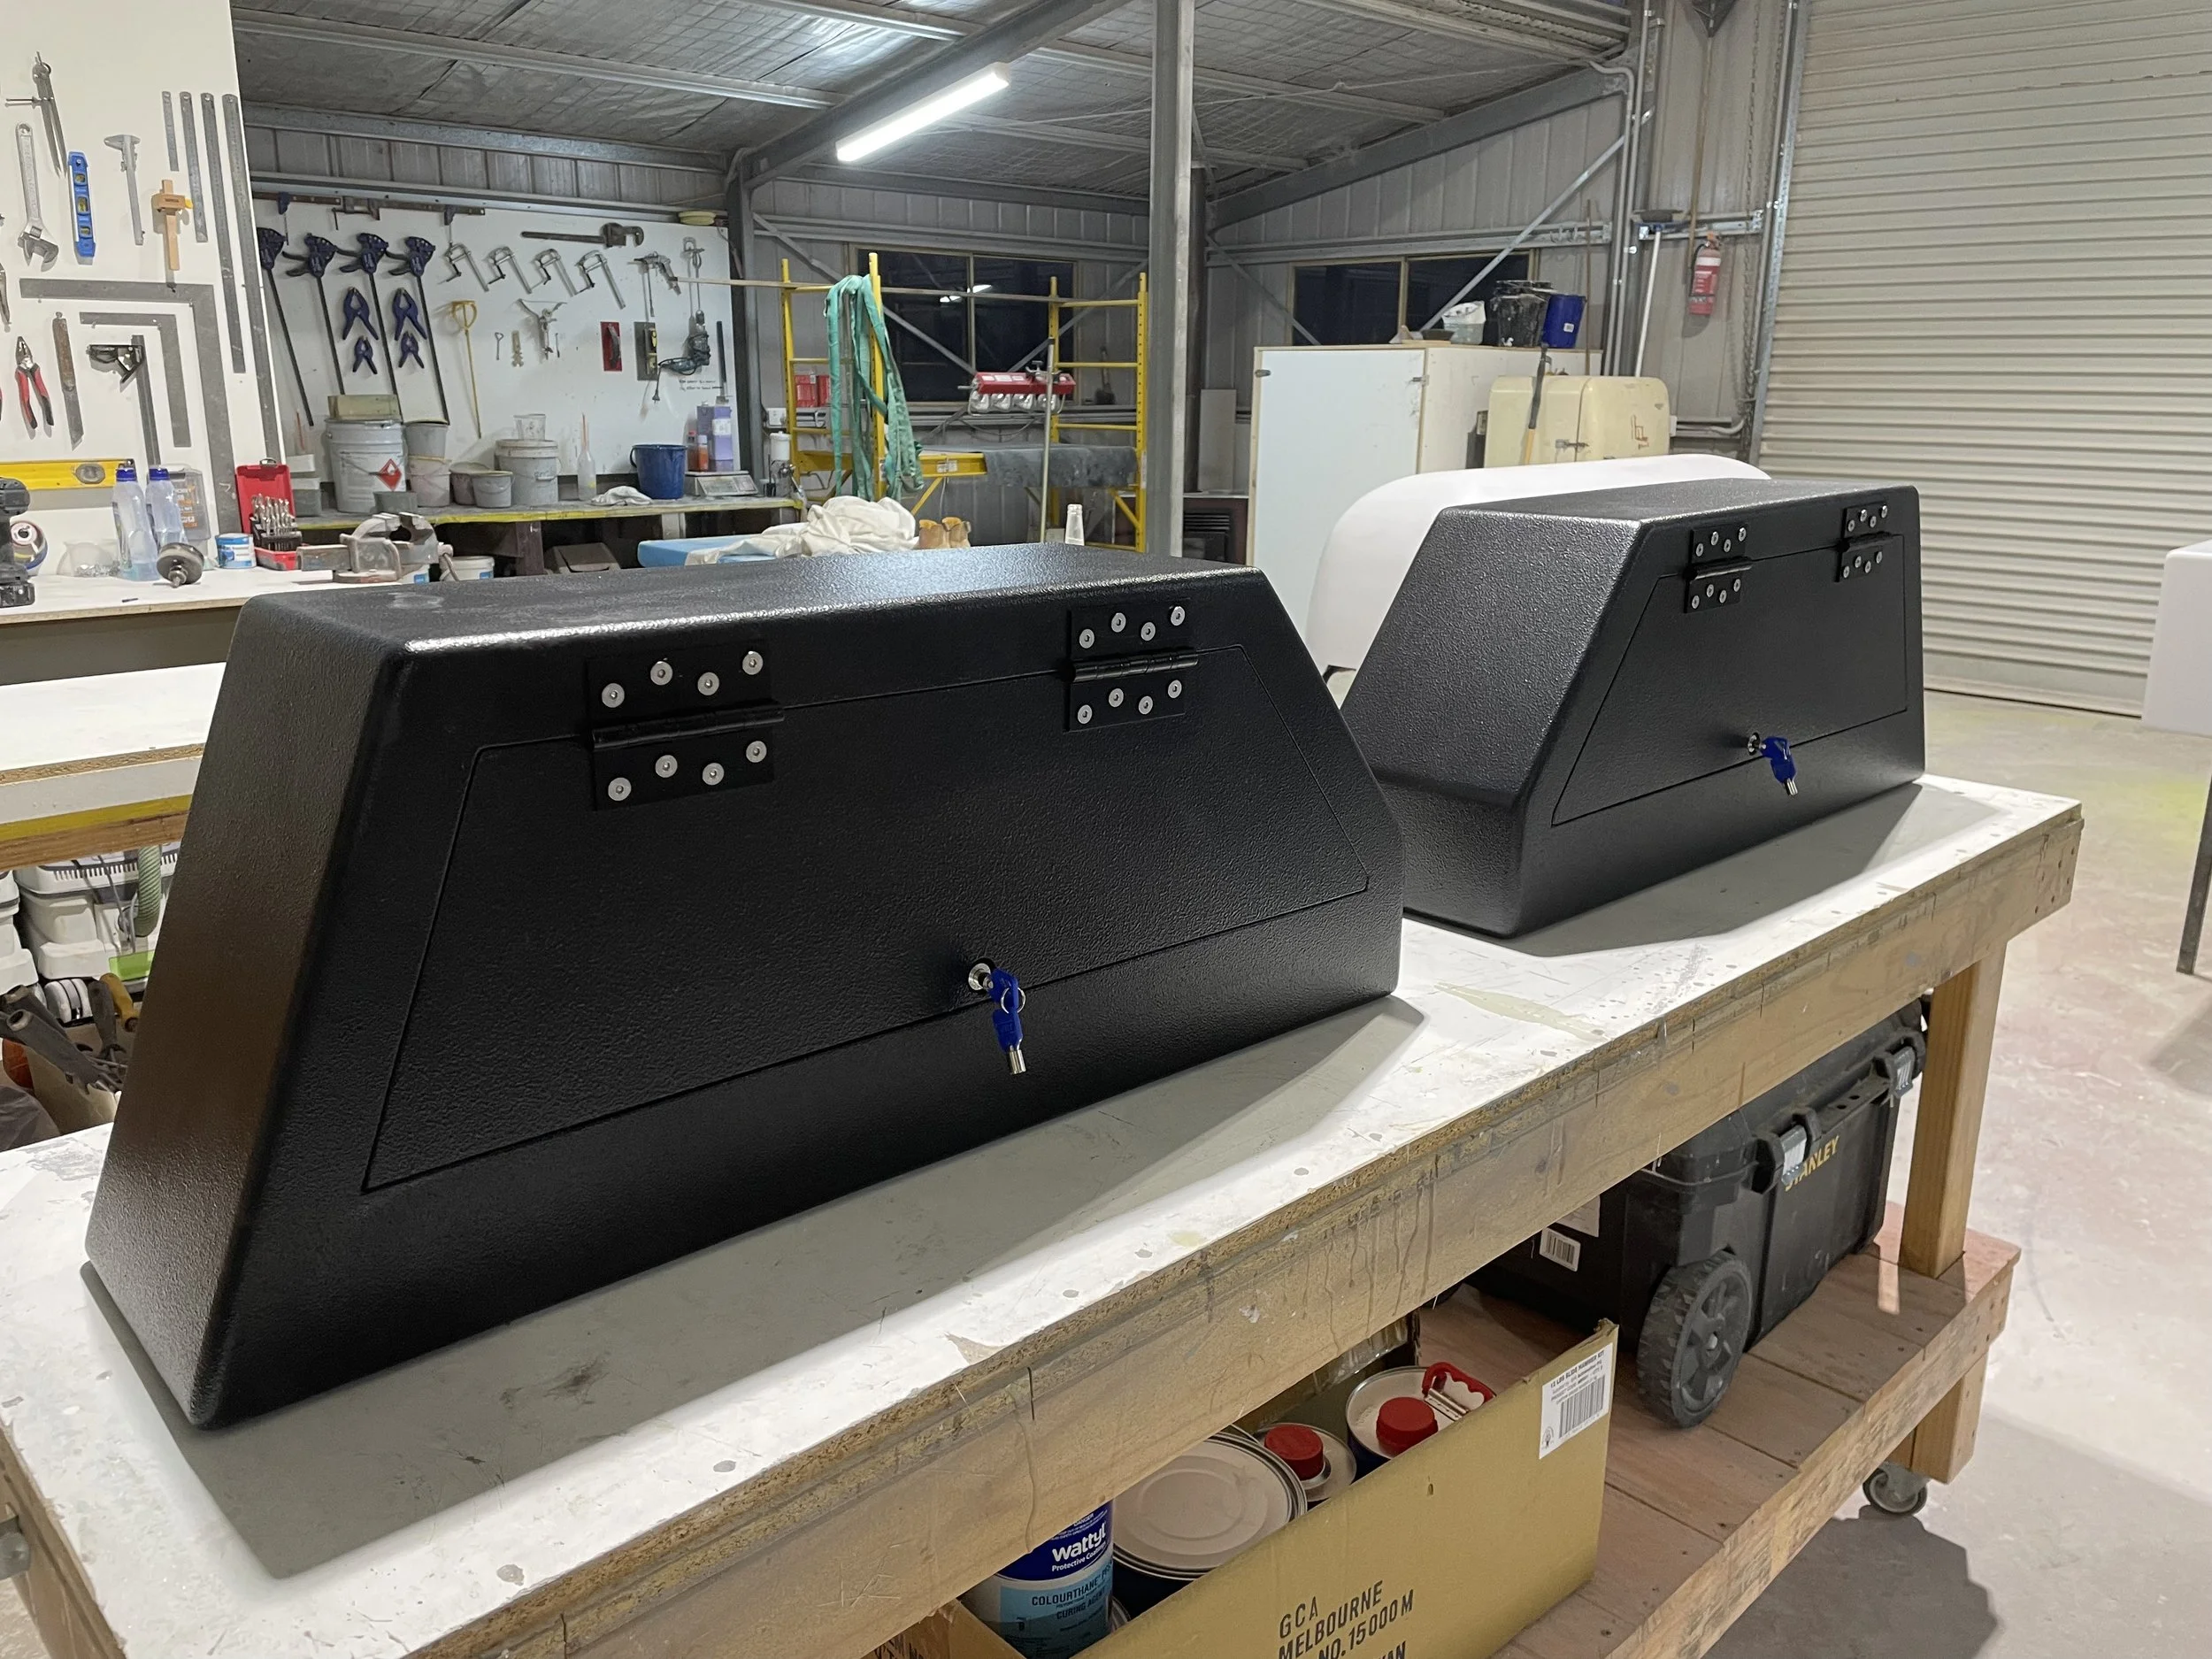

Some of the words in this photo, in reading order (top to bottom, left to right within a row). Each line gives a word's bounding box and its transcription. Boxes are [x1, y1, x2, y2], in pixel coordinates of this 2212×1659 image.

[1786, 1134, 1839, 1192] ANLEY
[1051, 1522, 1106, 1563] wattyl
[1051, 1556, 1086, 1572] Protective
[1032, 1575, 1100, 1606] COLOURTHANE
[1056, 1601, 1087, 1620] CURING
[1279, 1579, 1383, 1659] MELBOURNE
